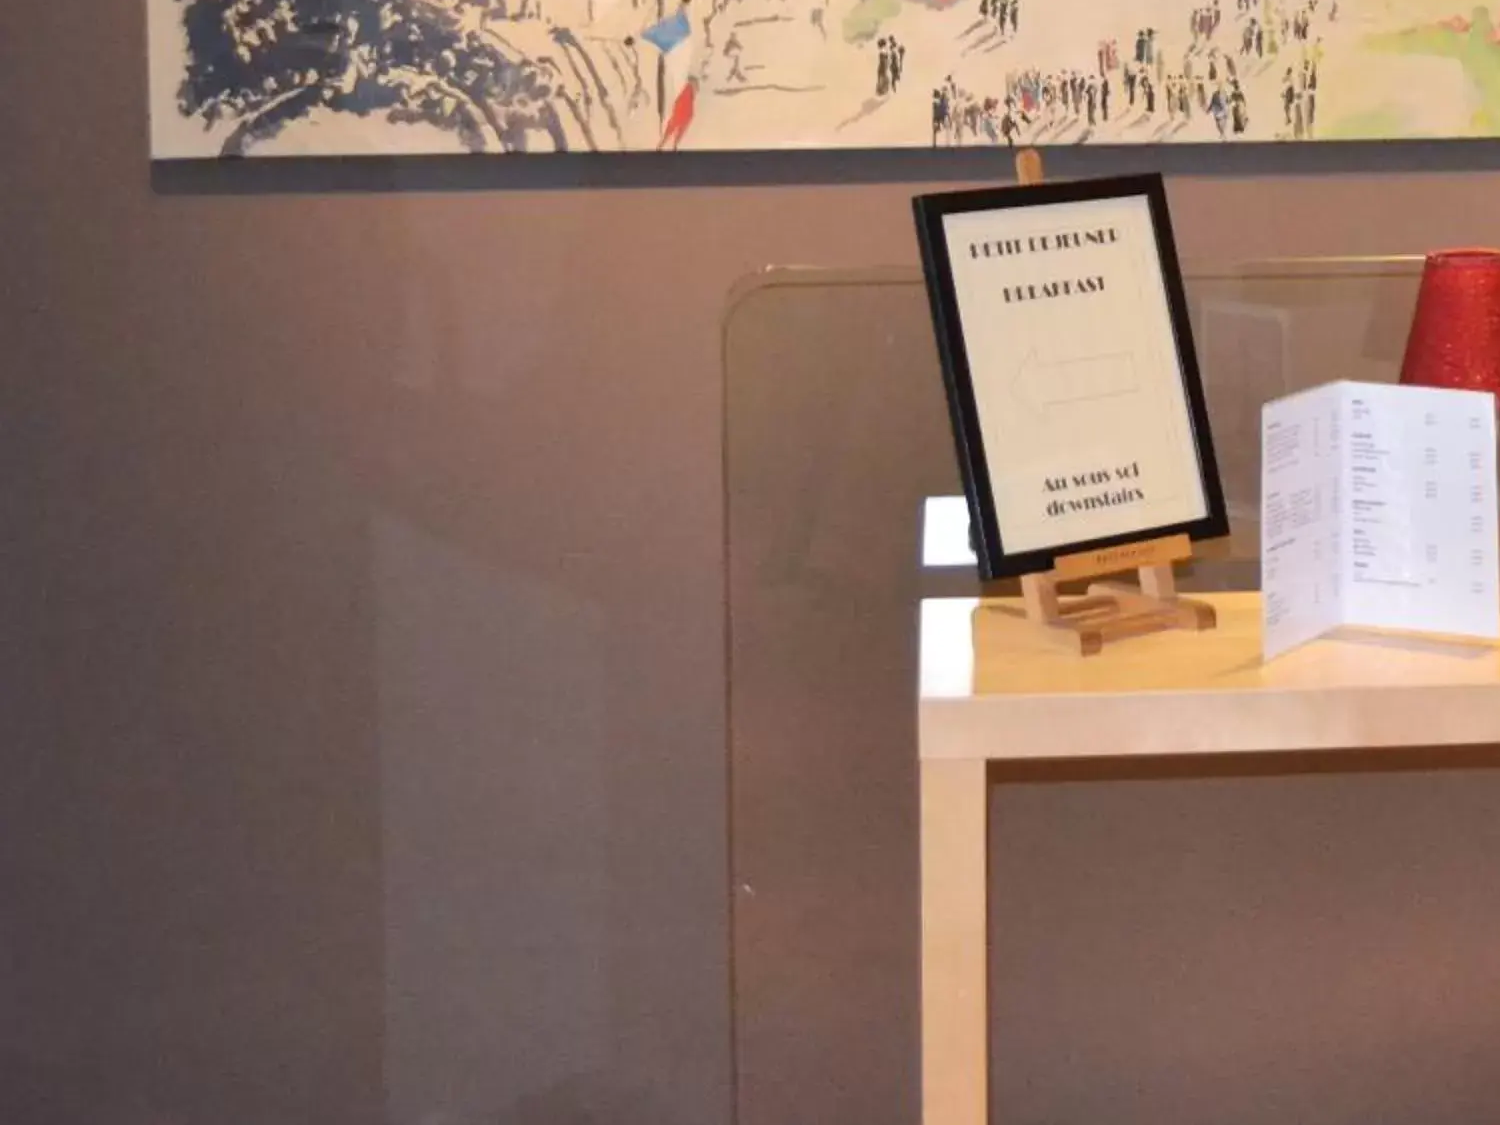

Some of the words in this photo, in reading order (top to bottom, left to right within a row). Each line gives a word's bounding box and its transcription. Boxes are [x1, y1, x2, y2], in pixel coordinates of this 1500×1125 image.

[1002, 275, 1106, 304] BREAKFAST
[1041, 476, 1068, 493] Au
[1072, 469, 1112, 488] sous
[1115, 461, 1140, 479] sol
[1045, 487, 1145, 517] downstairs
